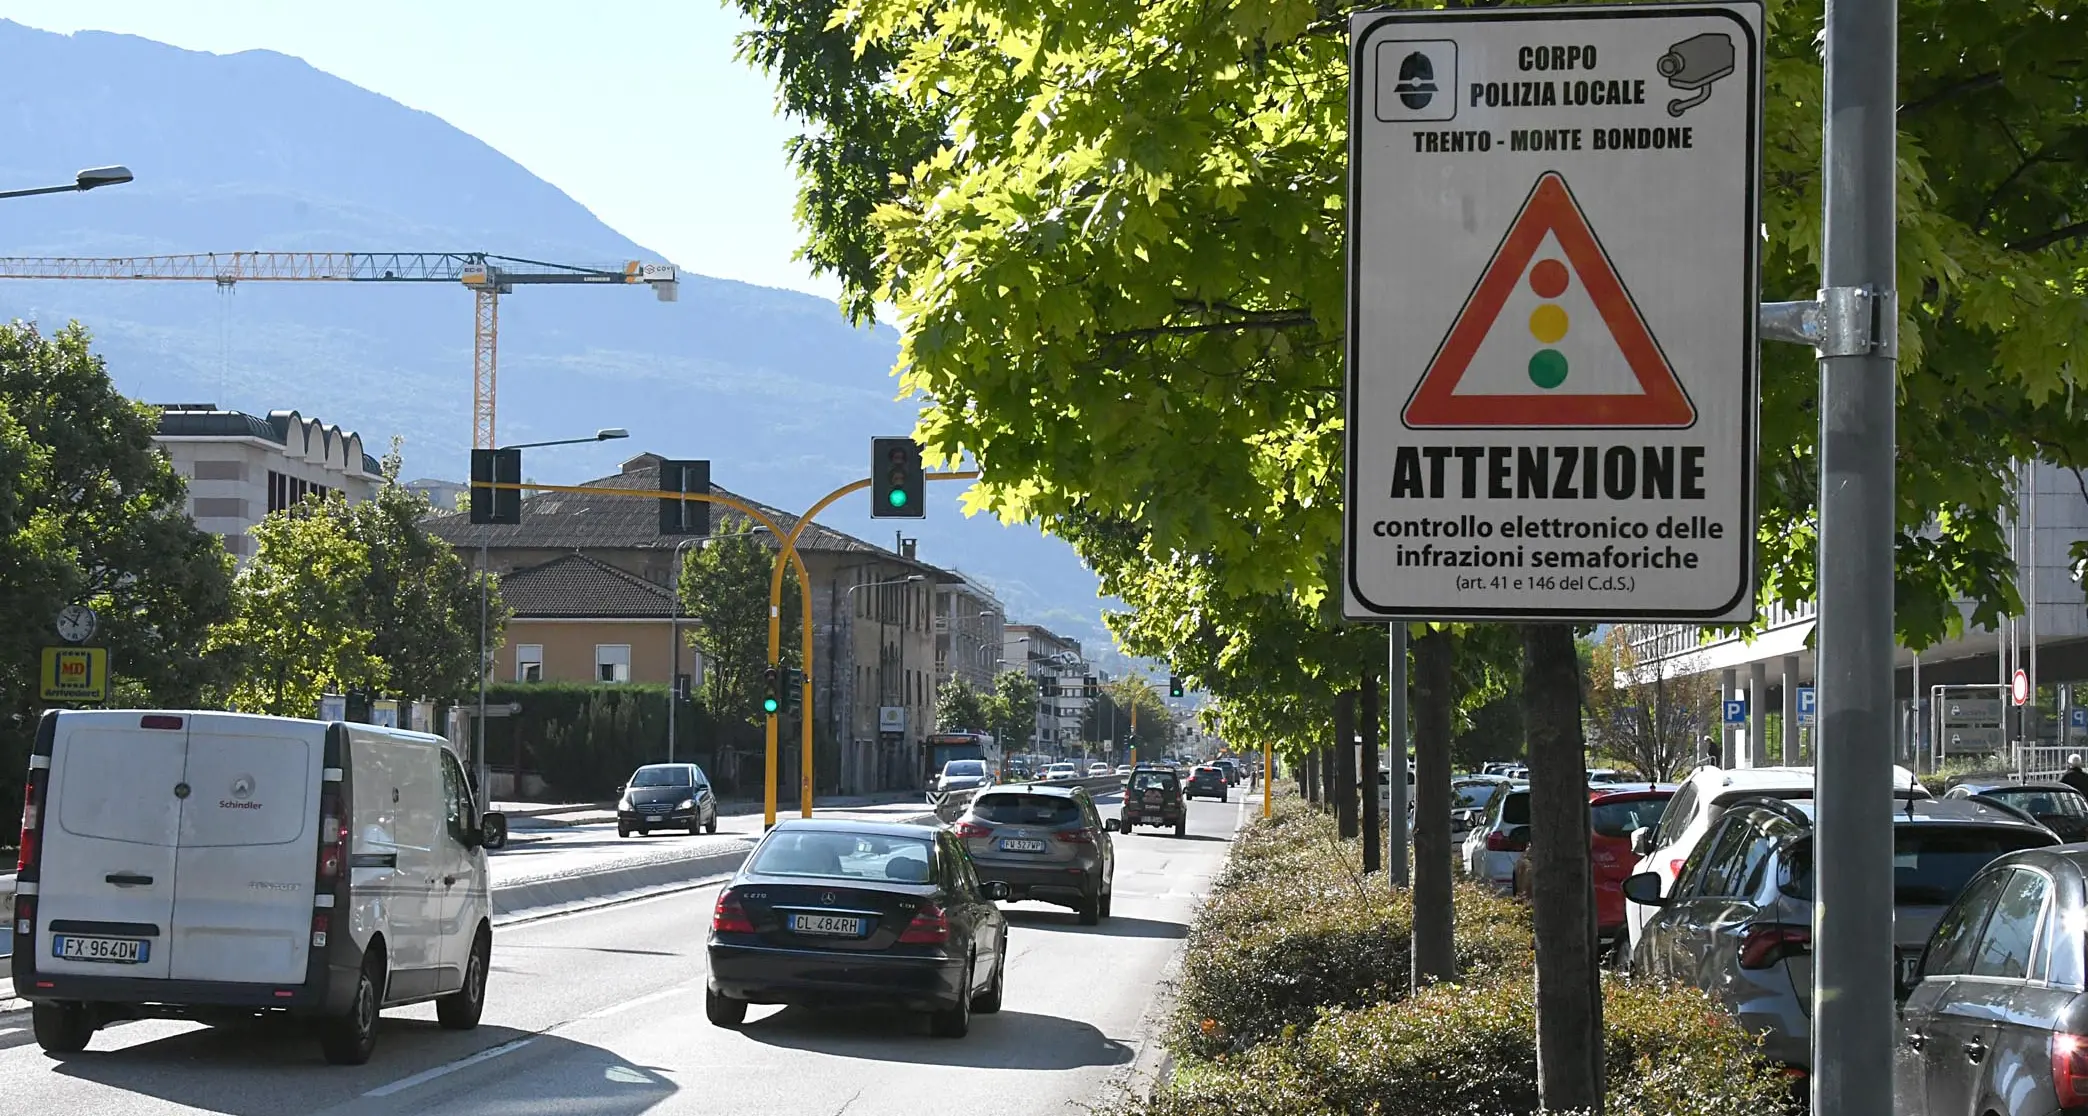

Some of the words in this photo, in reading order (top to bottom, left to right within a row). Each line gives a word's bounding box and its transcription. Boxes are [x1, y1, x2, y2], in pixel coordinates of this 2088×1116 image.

[1518, 44, 1597, 72] CORPO
[1470, 81, 1557, 108] POLIZIA
[1562, 79, 1646, 106] LOCALE
[1412, 130, 1492, 153] TRENTO
[1510, 128, 1582, 152] MONTE
[1592, 126, 1693, 151] BONDONE
[1390, 445, 1706, 501] ATTENZIONE
[1372, 514, 1494, 538] controllo
[1499, 514, 1649, 539] elettronico
[1655, 515, 1724, 540] delle
[1396, 543, 1524, 568] infrazioni
[1530, 544, 1699, 570] semaforiche
[1455, 574, 1487, 592] (art.
[1490, 575, 1507, 590] 41
[1513, 579, 1523, 590] e
[1527, 575, 1556, 591] 146
[1559, 575, 1584, 591] del
[1587, 575, 1636, 593] C.d.S.)
[62, 662, 85, 676] MD
[1727, 703, 1741, 720] P
[1801, 691, 1815, 711] P
[219, 800, 263, 810] Schindler
[796, 916, 811, 930] CL
[817, 916, 858, 933] 484RH
[65, 939, 84, 956] FX
[90, 940, 138, 960] 964DW
